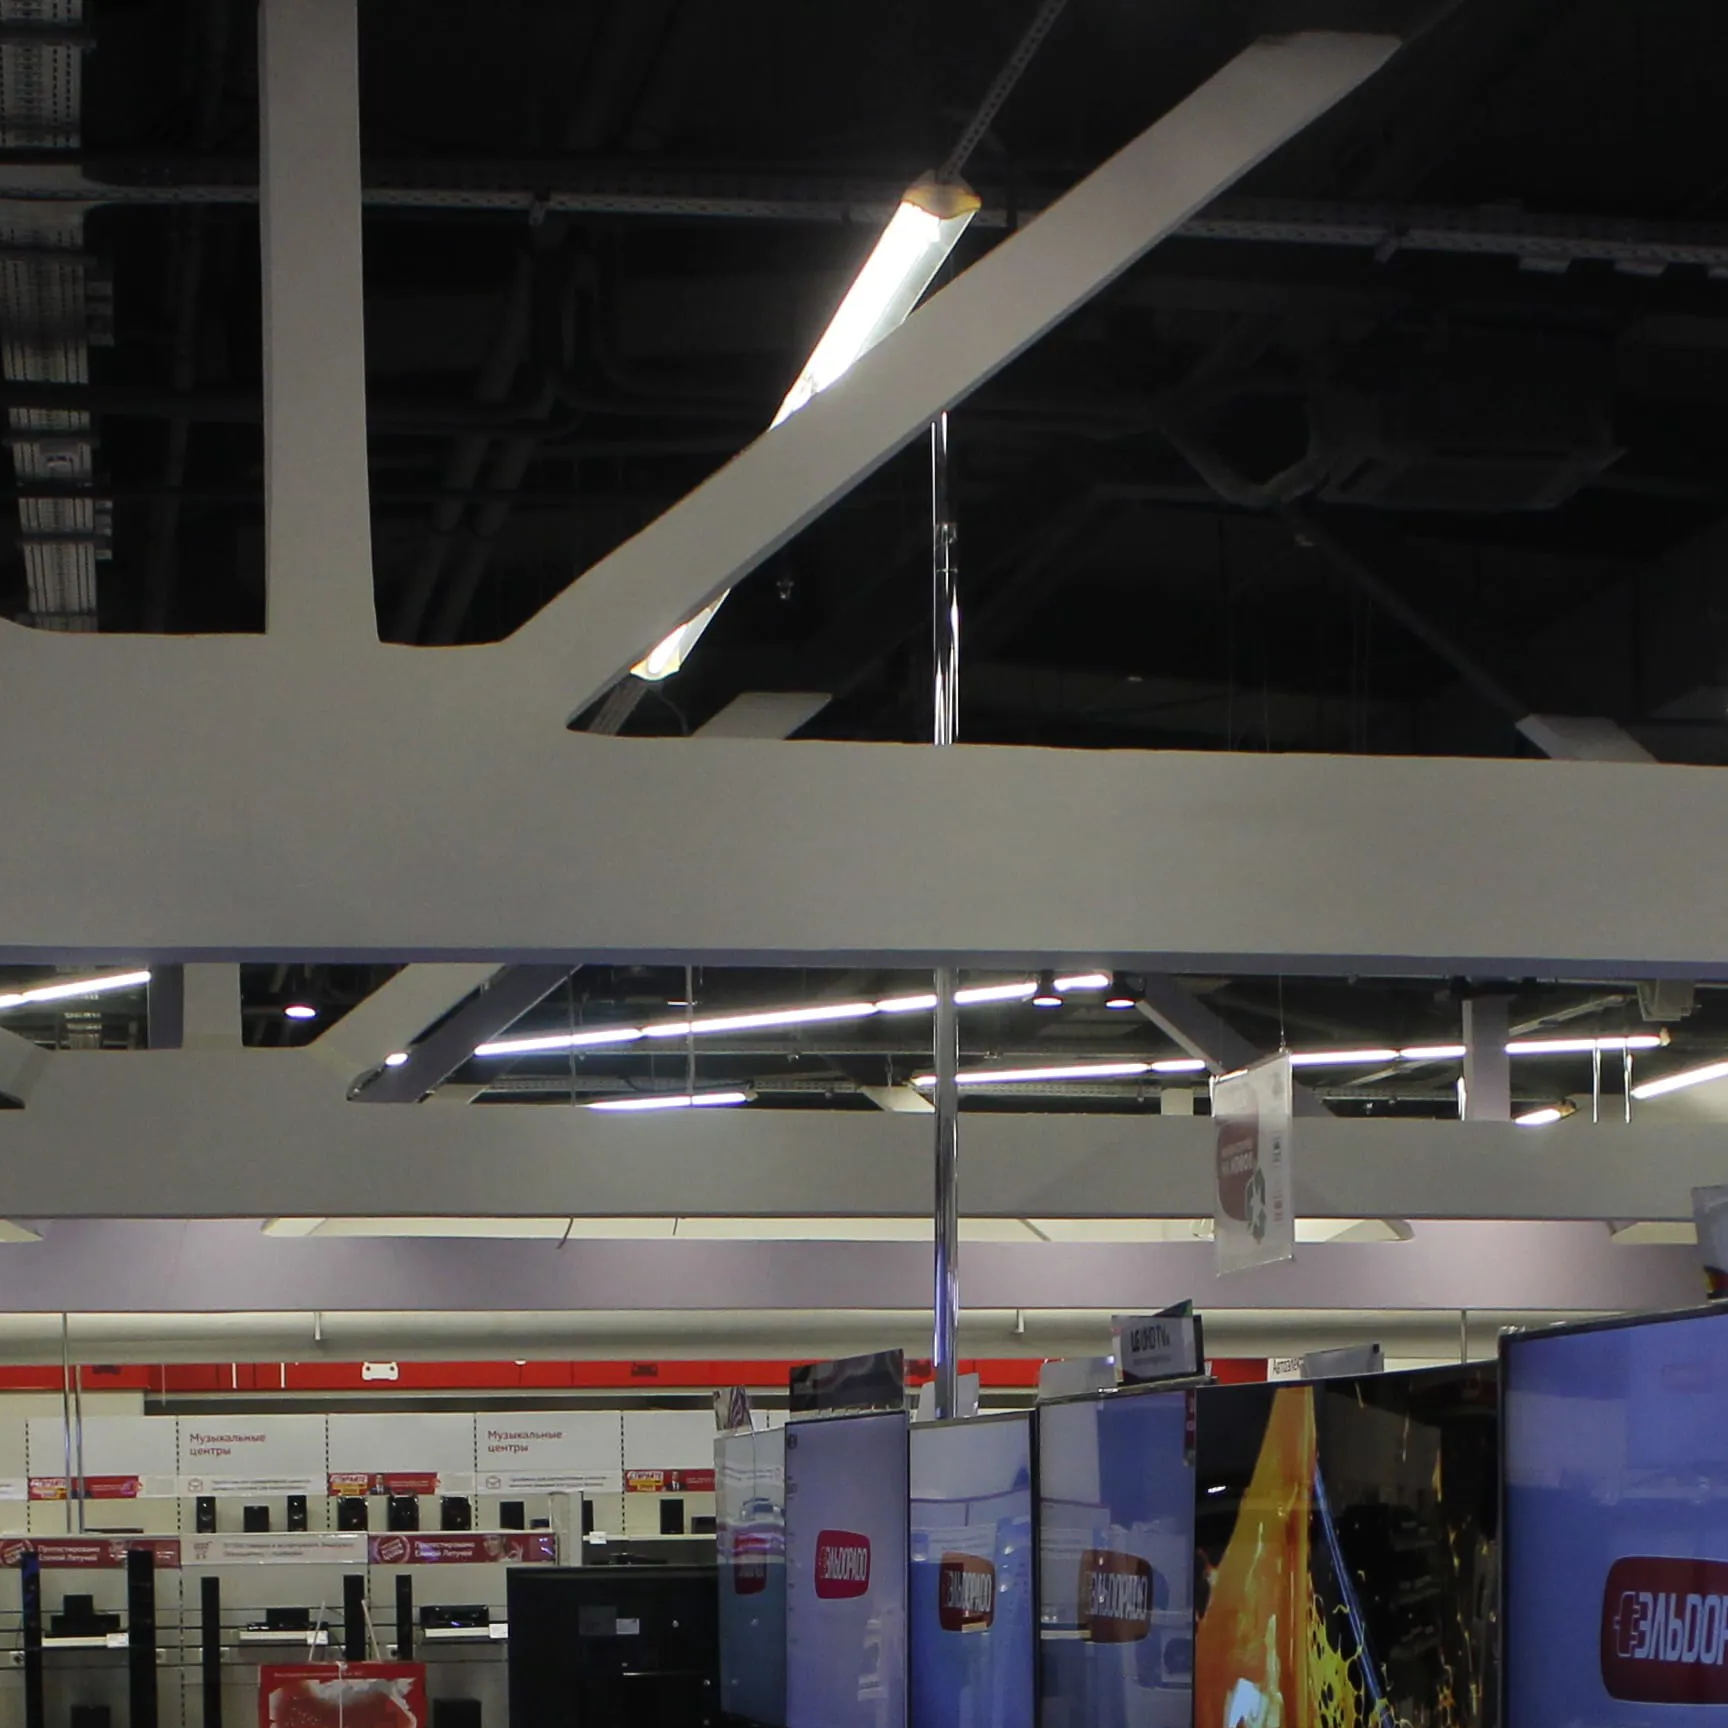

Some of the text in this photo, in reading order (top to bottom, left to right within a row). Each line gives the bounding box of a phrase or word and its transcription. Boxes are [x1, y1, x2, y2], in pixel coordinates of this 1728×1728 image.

[190, 1433, 266, 1446] Музыкальные
[488, 1429, 563, 1442] Музыкальные
[190, 1446, 232, 1457] центры
[488, 1442, 529, 1455] центры
